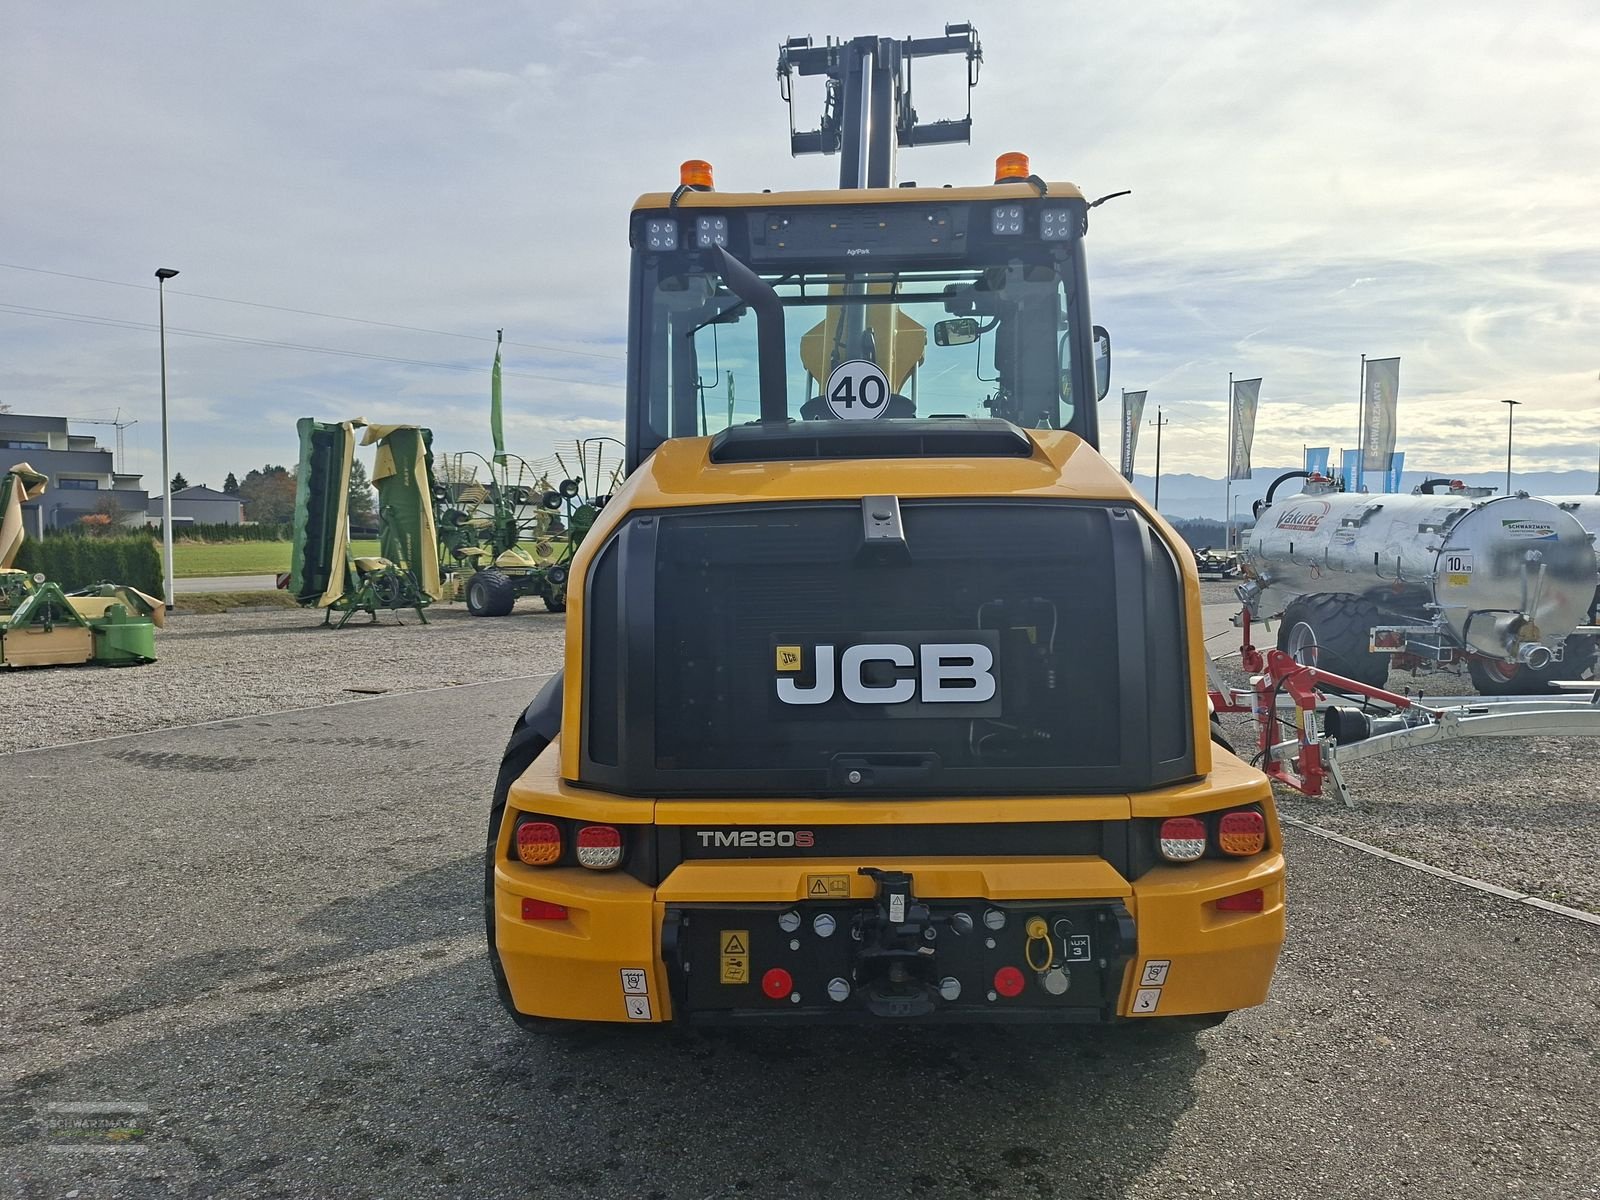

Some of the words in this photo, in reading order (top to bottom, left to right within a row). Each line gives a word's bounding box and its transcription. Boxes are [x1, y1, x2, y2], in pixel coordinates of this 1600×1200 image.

[831, 375, 886, 409] 40
[1370, 381, 1382, 457] SCHWARZMAYR
[1275, 507, 1325, 529] Vakutec
[1447, 557, 1461, 572] 10
[1462, 564, 1472, 572] km
[783, 652, 797, 664] JCB
[776, 644, 996, 705] JCB
[697, 830, 815, 848] TM280S
[1073, 947, 1082, 955] 3
